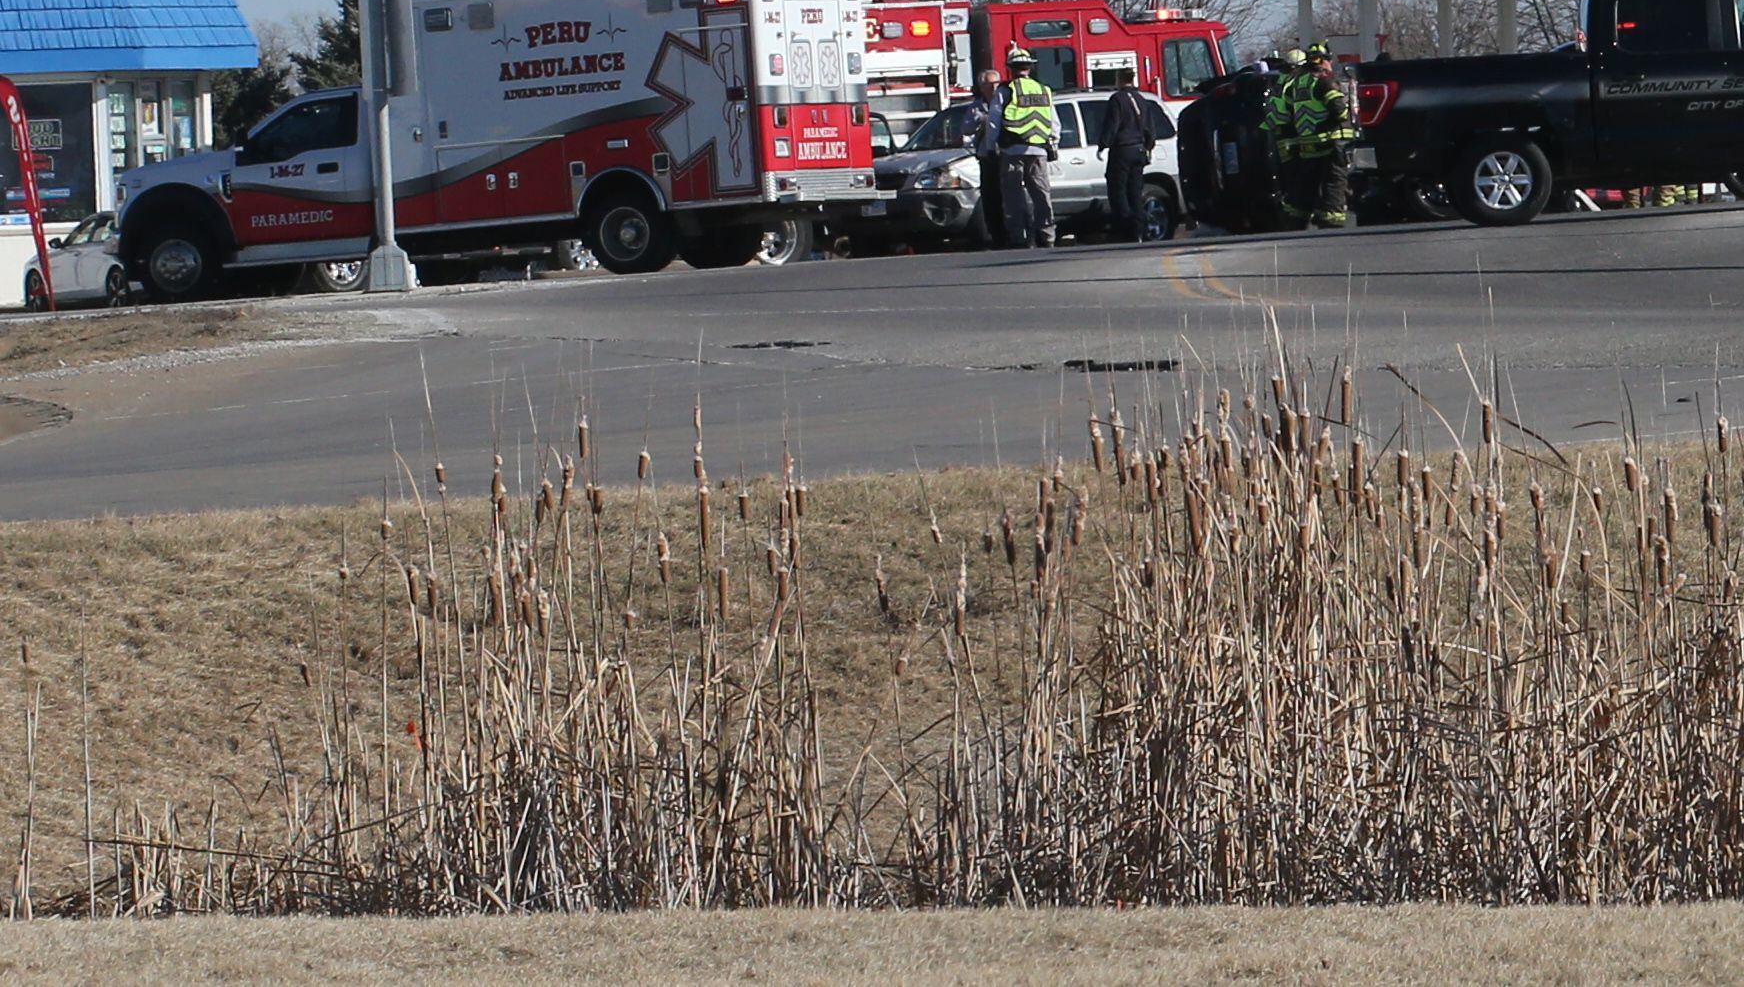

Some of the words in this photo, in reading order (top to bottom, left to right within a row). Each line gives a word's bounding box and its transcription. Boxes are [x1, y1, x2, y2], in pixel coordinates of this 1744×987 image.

[524, 21, 592, 49] PERU
[499, 52, 626, 82] AMBULANCE
[503, 85, 555, 101] ADVANCED
[556, 83, 578, 96] LIFE
[578, 80, 622, 95] SUPPORT
[1606, 79, 1718, 96] COMMUNITY
[1687, 100, 1721, 111] CITY
[1723, 99, 1744, 109] OF
[798, 141, 848, 160] AMBULANCE
[251, 209, 334, 228] PARAMEDIC
